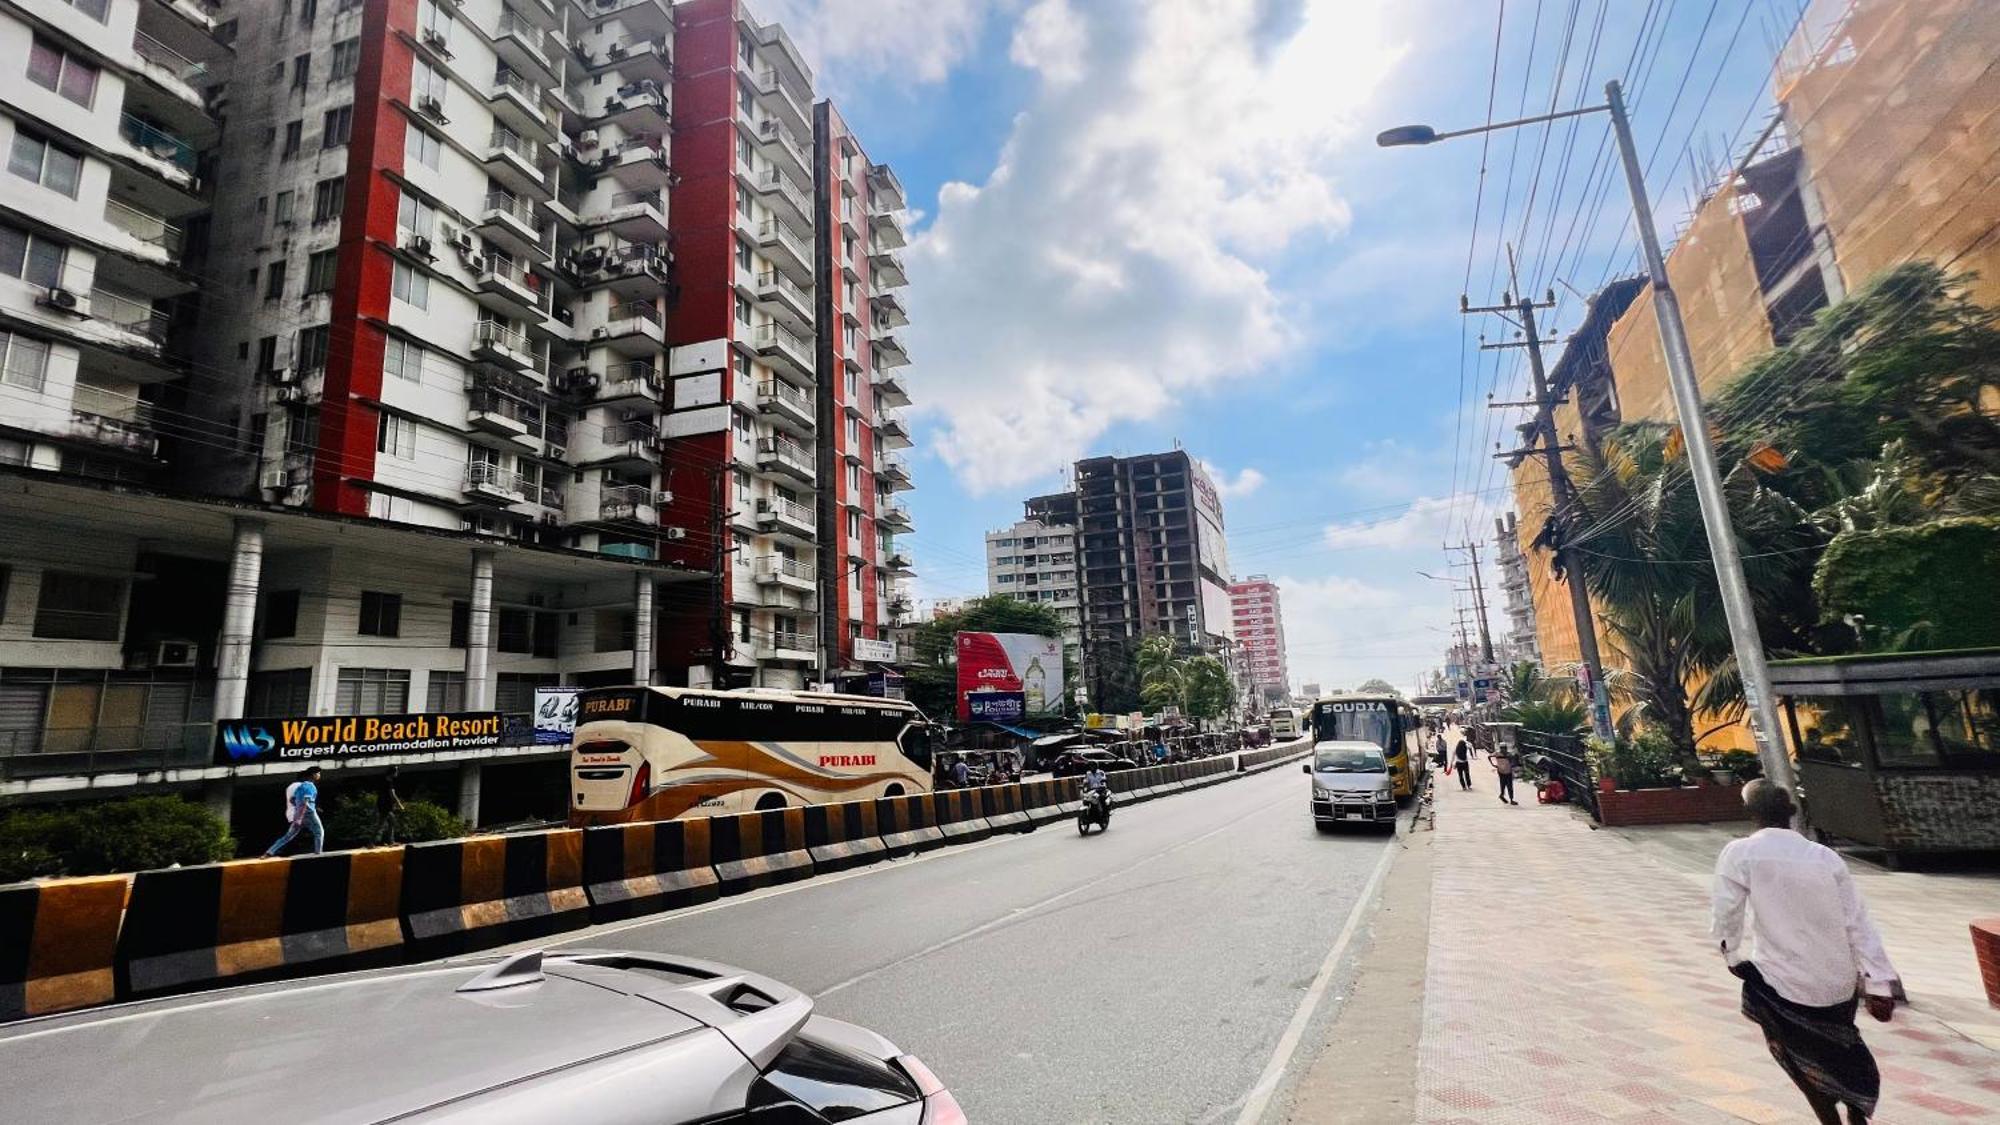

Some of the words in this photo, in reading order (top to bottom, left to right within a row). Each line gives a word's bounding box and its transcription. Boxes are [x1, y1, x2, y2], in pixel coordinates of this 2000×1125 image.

[585, 698, 630, 712] PURABI
[683, 698, 721, 708] PURABI
[740, 702, 773, 711] AIR/CON
[1322, 702, 1387, 714] SOUDIA
[795, 705, 824, 714] PURABI
[281, 718, 356, 743] World
[364, 714, 429, 741] Beach
[436, 715, 499, 737] Resort
[280, 744, 335, 758] Largest
[338, 738, 449, 754] Accommodation
[452, 735, 499, 747] Provider
[819, 755, 876, 767] PURABI
